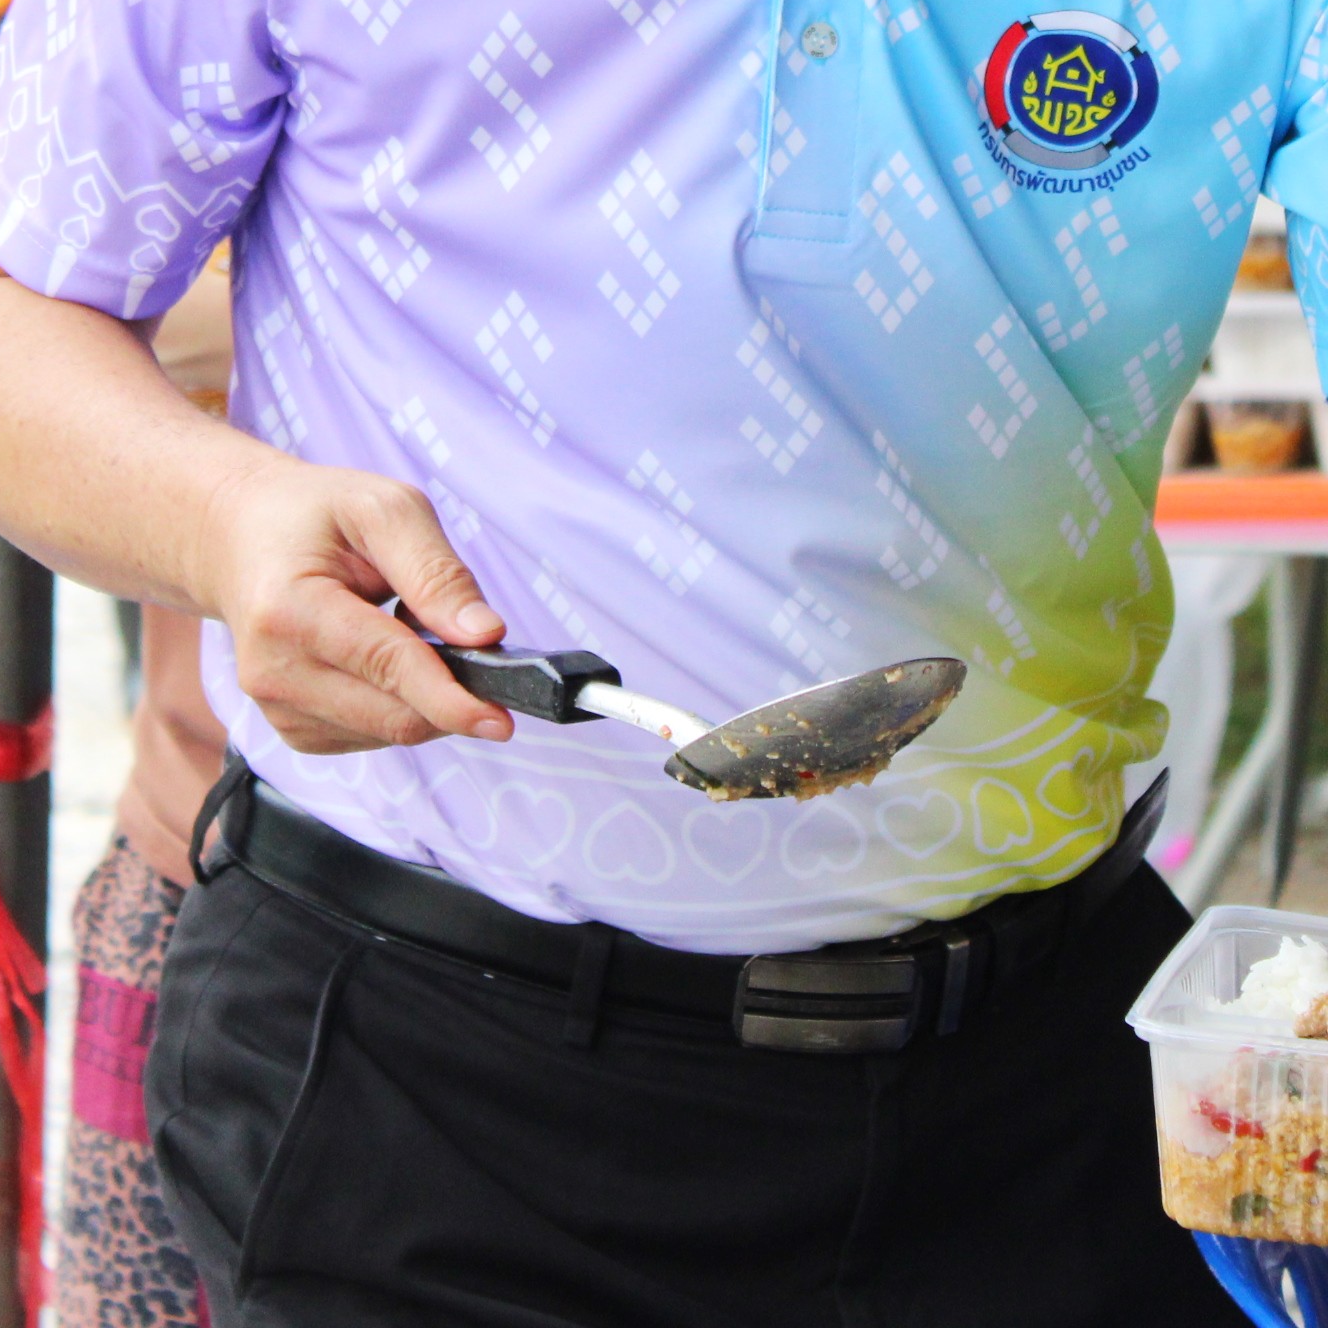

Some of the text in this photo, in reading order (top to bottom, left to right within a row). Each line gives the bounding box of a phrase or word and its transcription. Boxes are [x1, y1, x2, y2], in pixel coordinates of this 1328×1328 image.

[977, 121, 1152, 193] กรมการพัฒนาชุมชน
